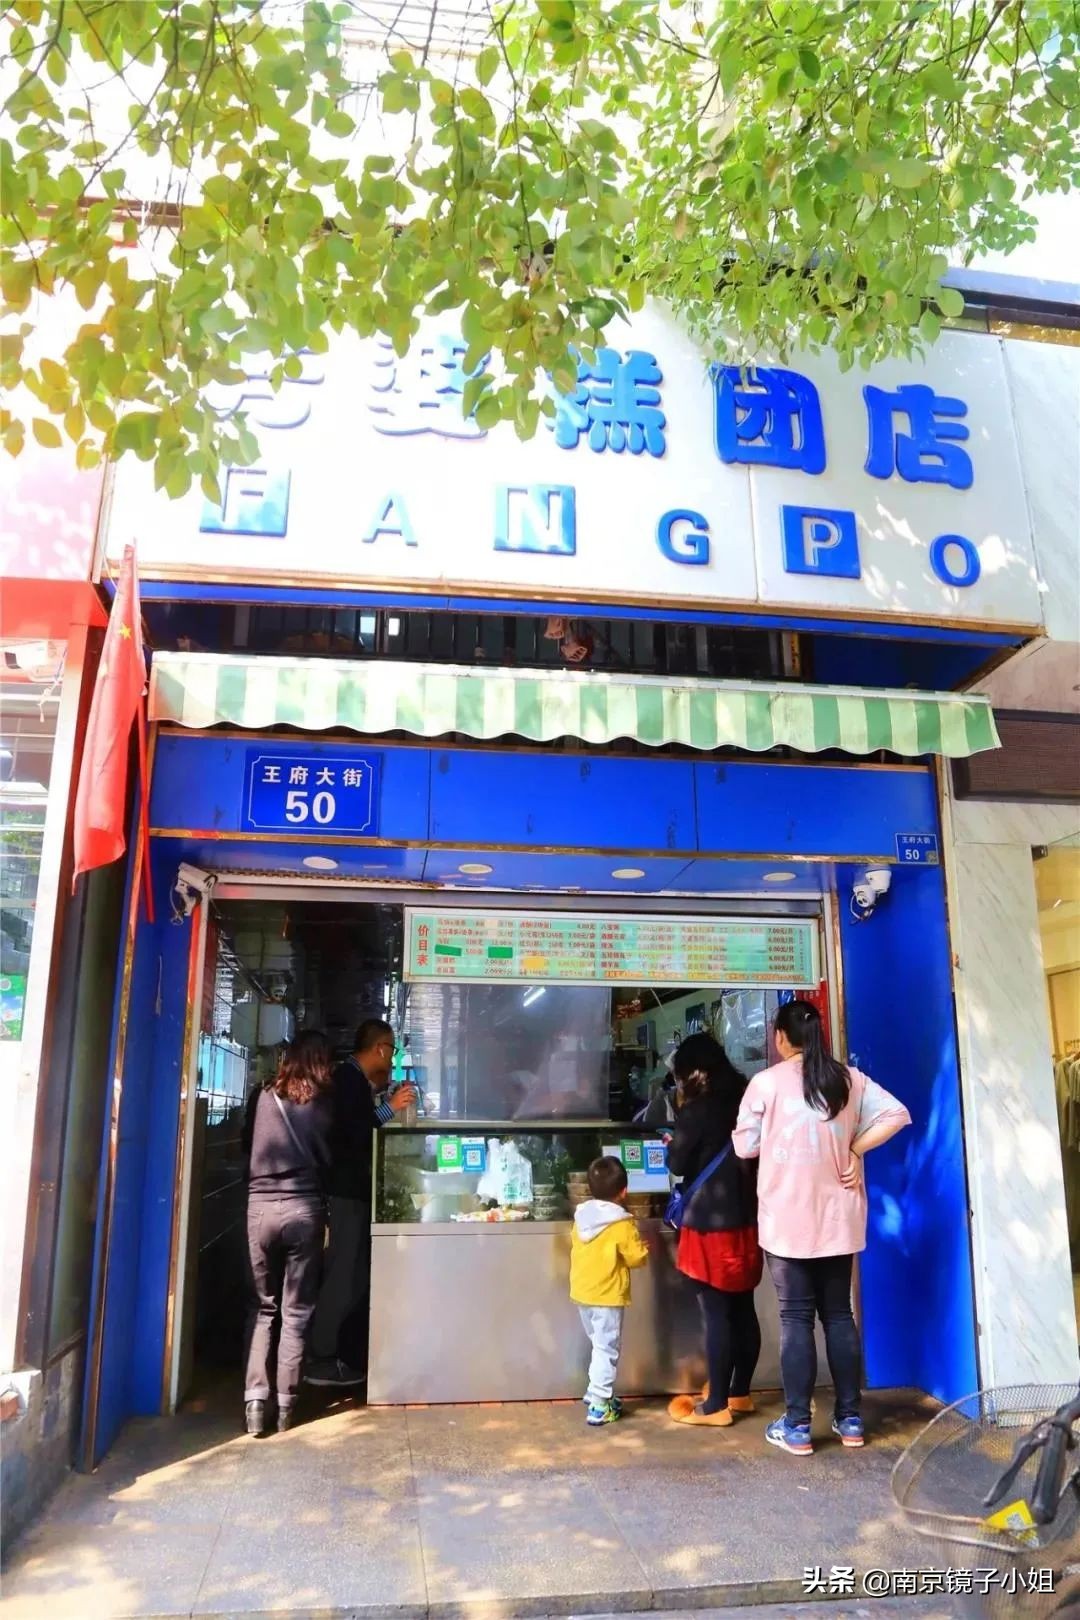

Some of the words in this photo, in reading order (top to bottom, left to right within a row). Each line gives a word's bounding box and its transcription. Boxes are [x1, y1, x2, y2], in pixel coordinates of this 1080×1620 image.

[262, 765, 363, 787] 王府大街
[285, 790, 336, 824] 50
[901, 836, 931, 844] 王府大街
[905, 849, 920, 860] 50
[416, 924, 430, 967] 价目表
